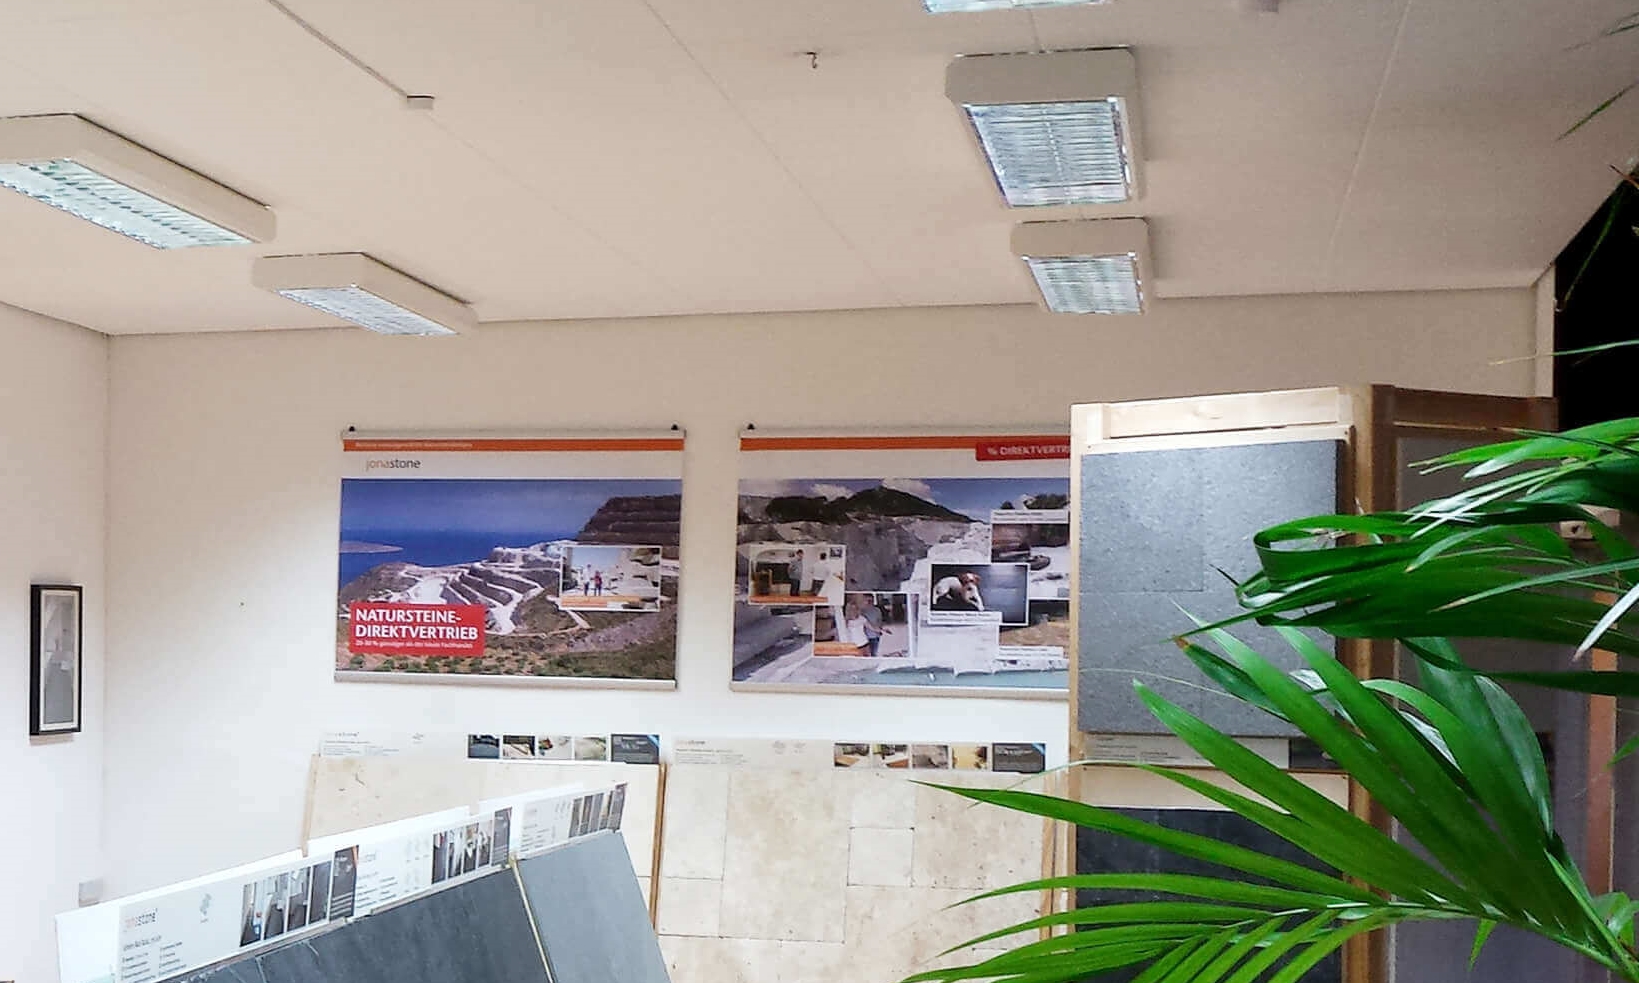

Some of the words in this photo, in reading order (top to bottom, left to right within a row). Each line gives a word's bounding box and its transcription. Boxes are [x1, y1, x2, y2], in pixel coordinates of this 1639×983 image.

[365, 458, 421, 471] jonastone
[355, 608, 462, 623] NATURSTEINE-
[355, 624, 479, 640] DIREKTVERTRIEB
